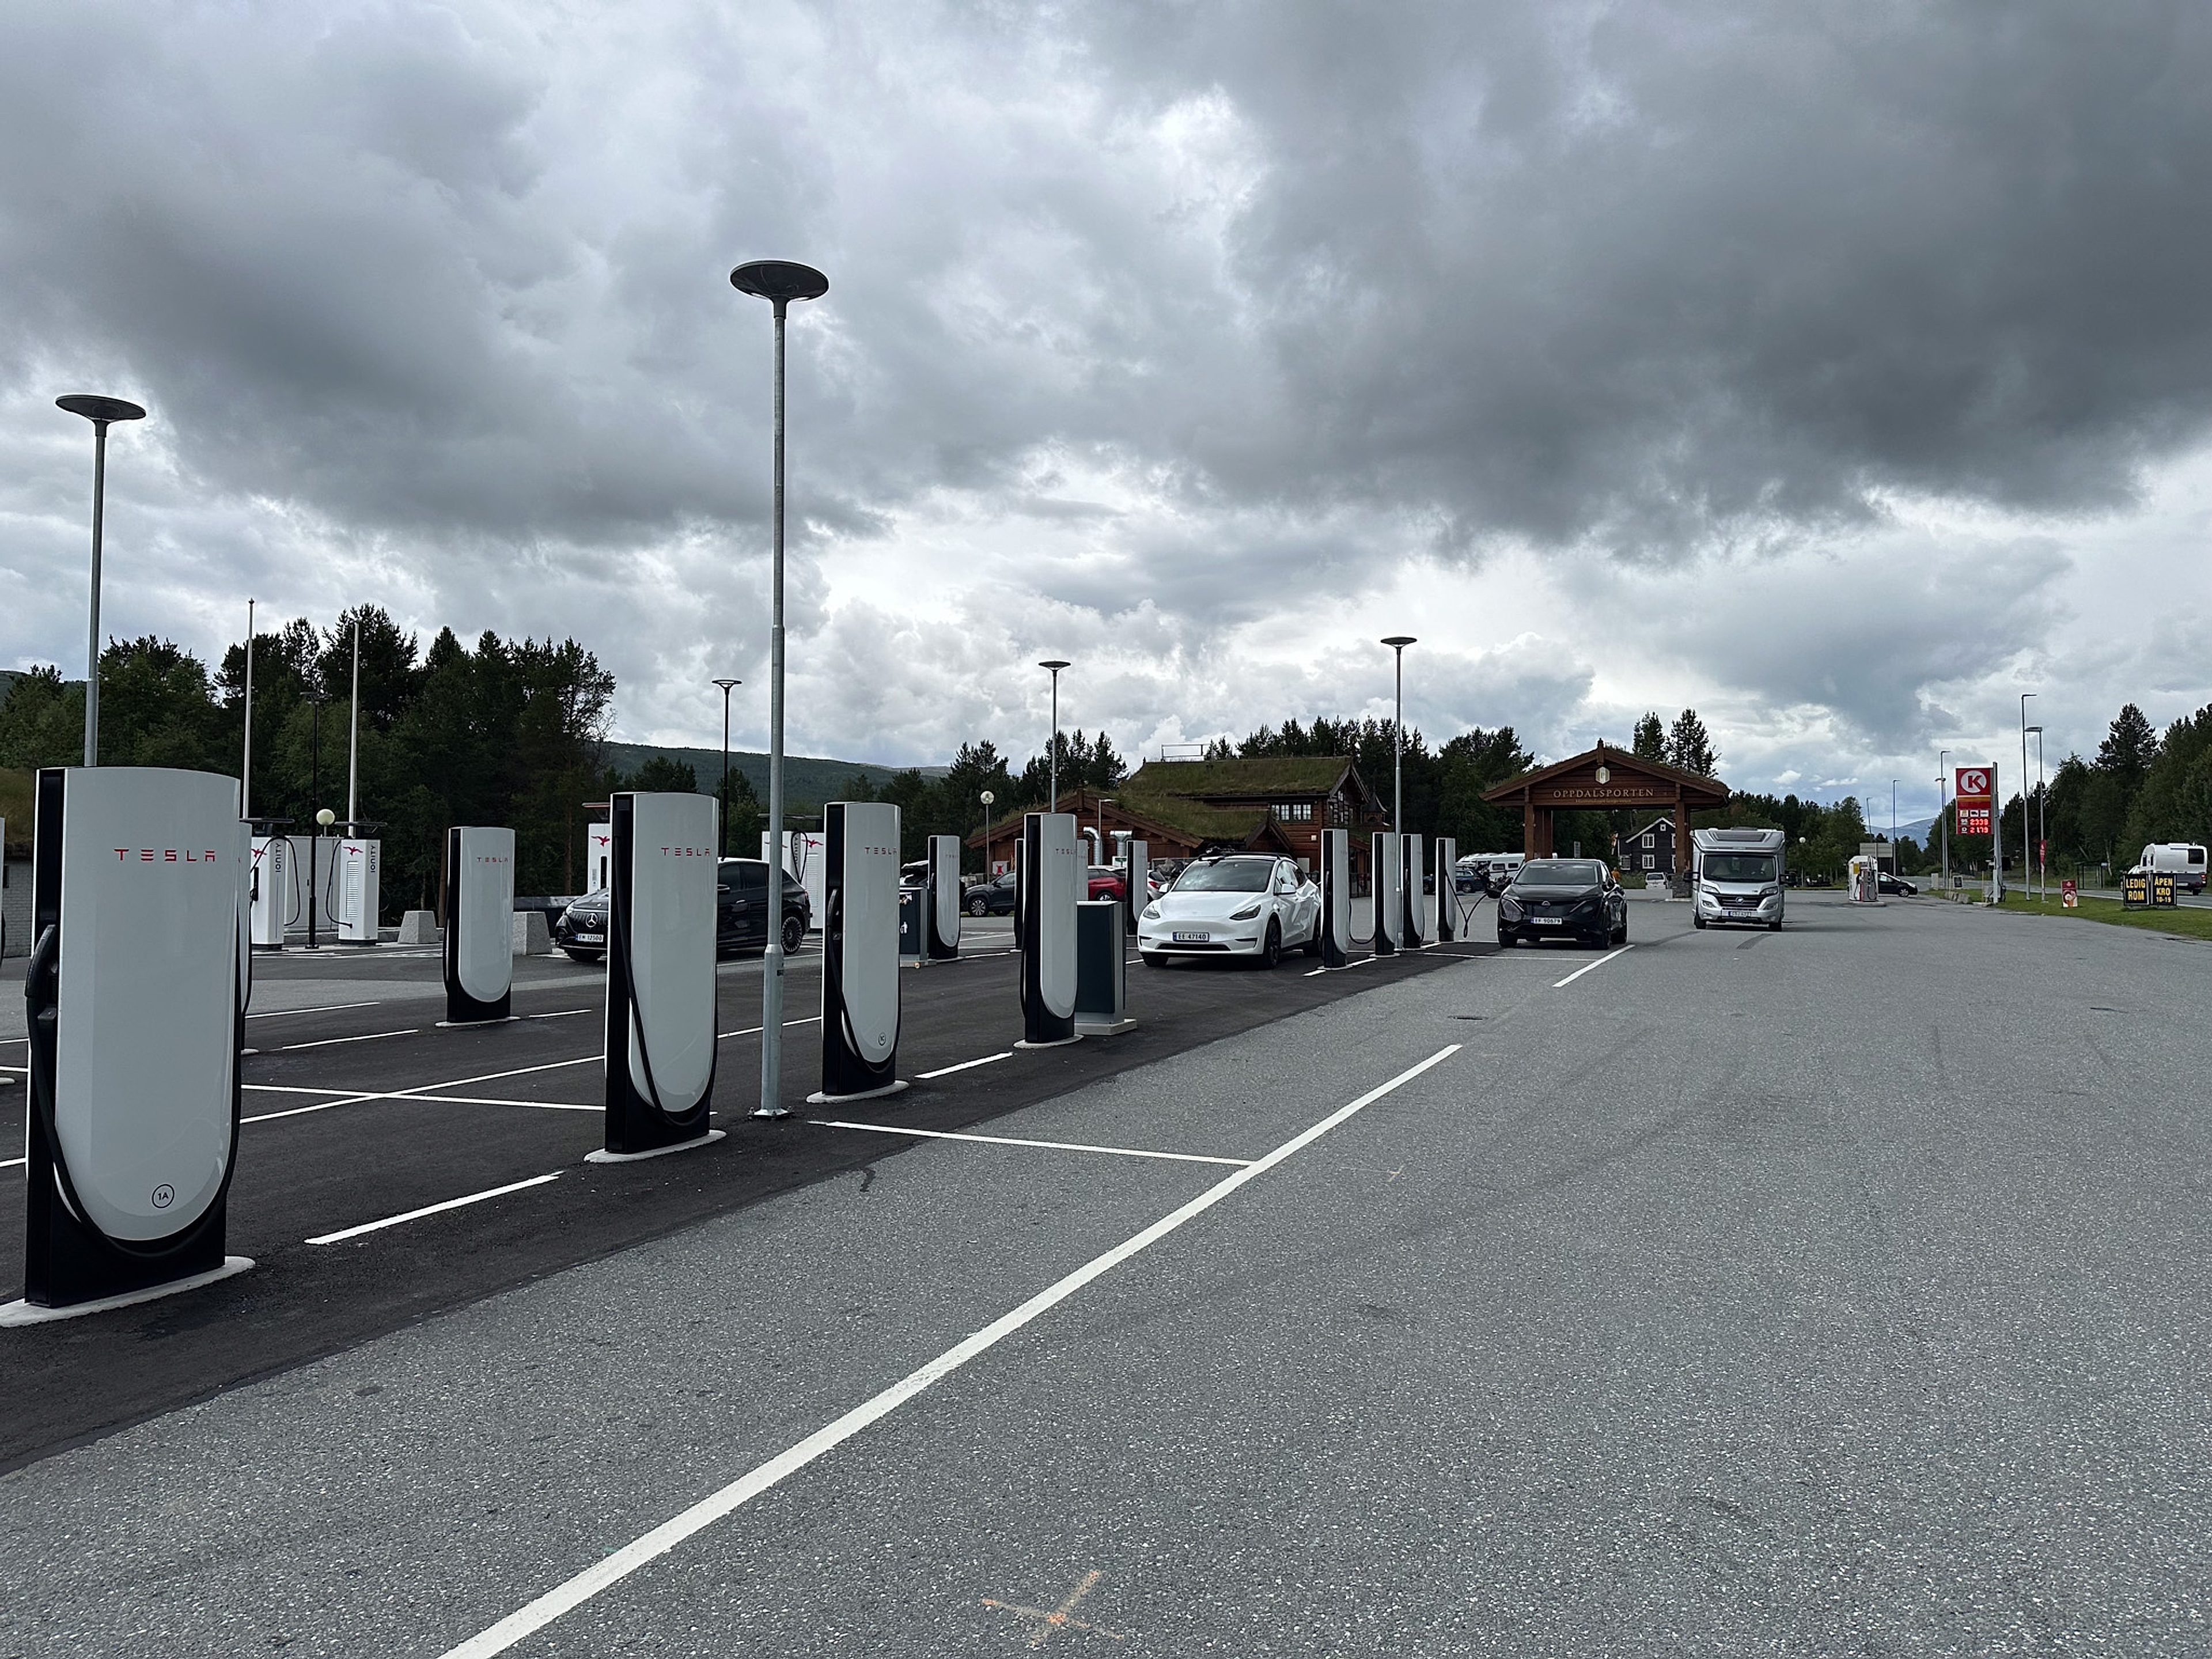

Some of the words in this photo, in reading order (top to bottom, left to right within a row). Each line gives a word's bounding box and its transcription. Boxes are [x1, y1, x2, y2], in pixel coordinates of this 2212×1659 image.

[1968, 775, 1983, 791] K
[1553, 789, 1654, 798] OPPDALSPORTEN
[113, 849, 215, 862] TESLA
[661, 847, 710, 856] TESLA
[865, 847, 897, 855] TESLA
[2126, 878, 2146, 888] LEDIG
[2154, 876, 2173, 887] ÅPEN
[2128, 891, 2144, 900] ROM
[2156, 888, 2171, 896] KRO
[158, 1192, 169, 1200] 1A
